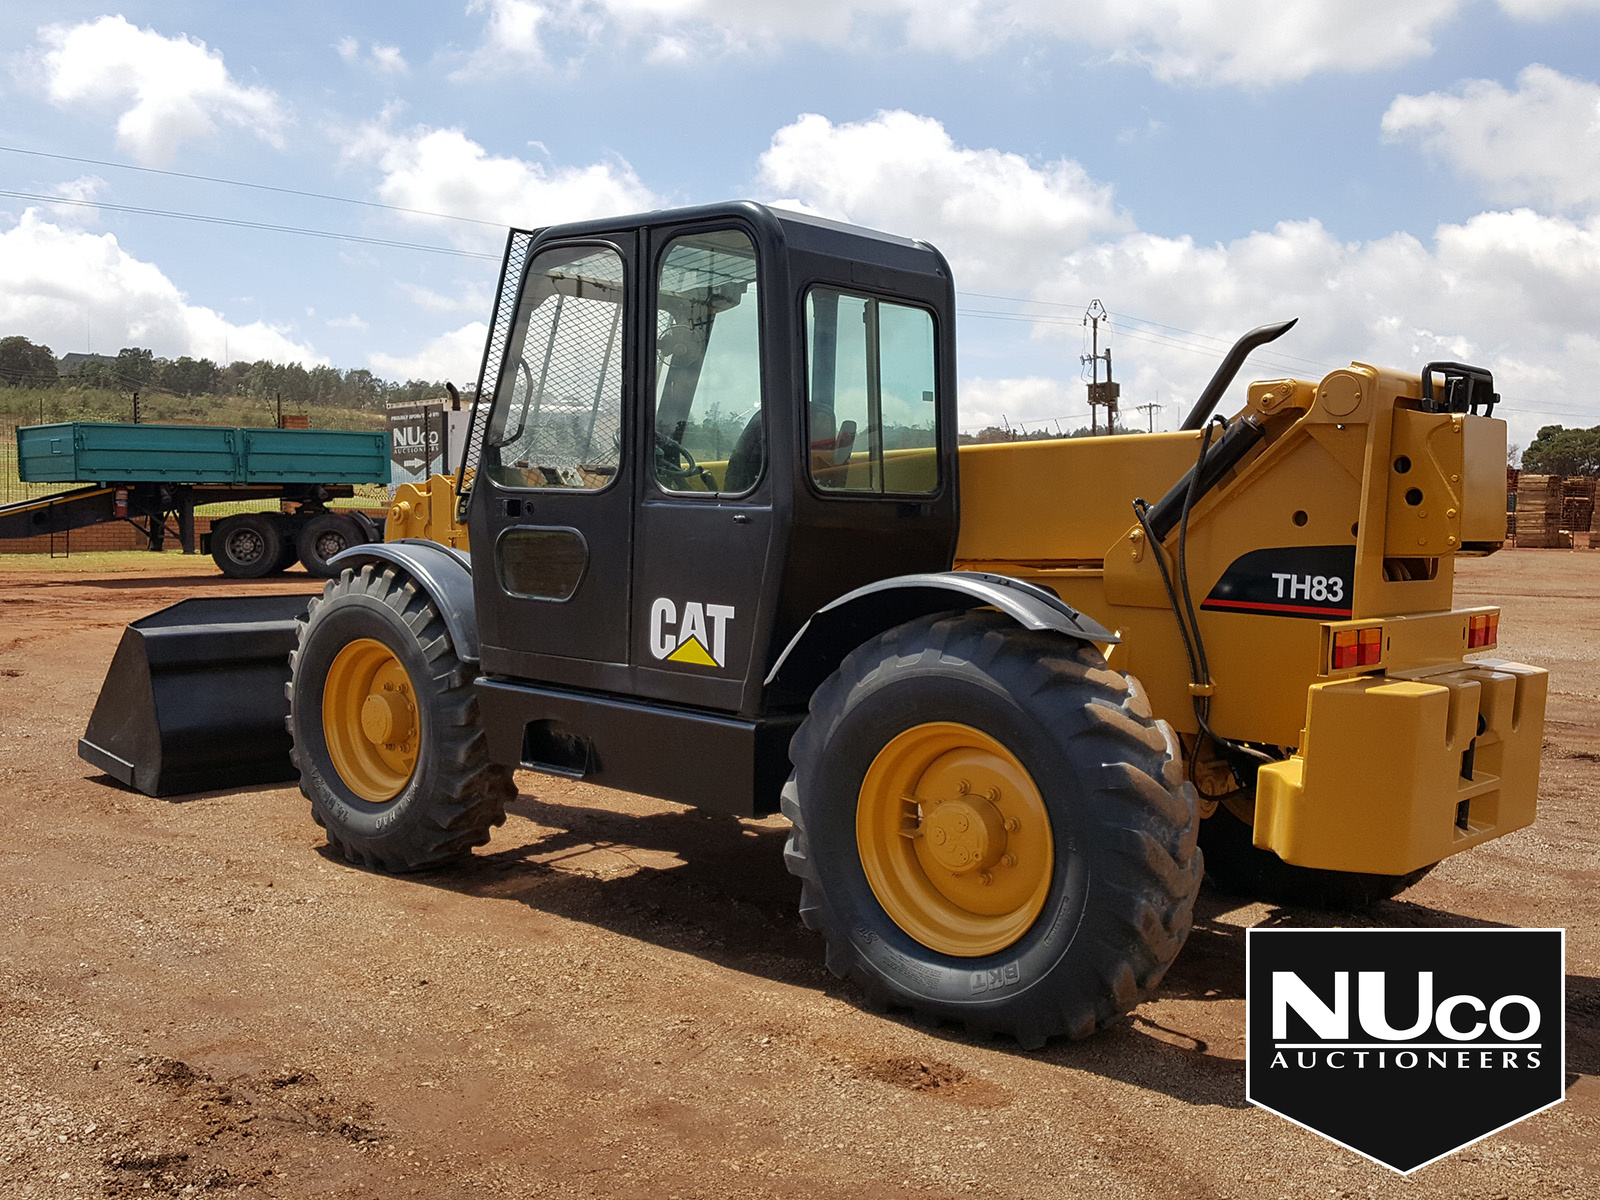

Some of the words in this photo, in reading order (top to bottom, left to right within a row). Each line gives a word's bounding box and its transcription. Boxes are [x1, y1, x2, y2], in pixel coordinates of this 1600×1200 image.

[1272, 572, 1344, 602] TH83
[650, 597, 735, 668] CAT
[969, 961, 1021, 995] BKT
